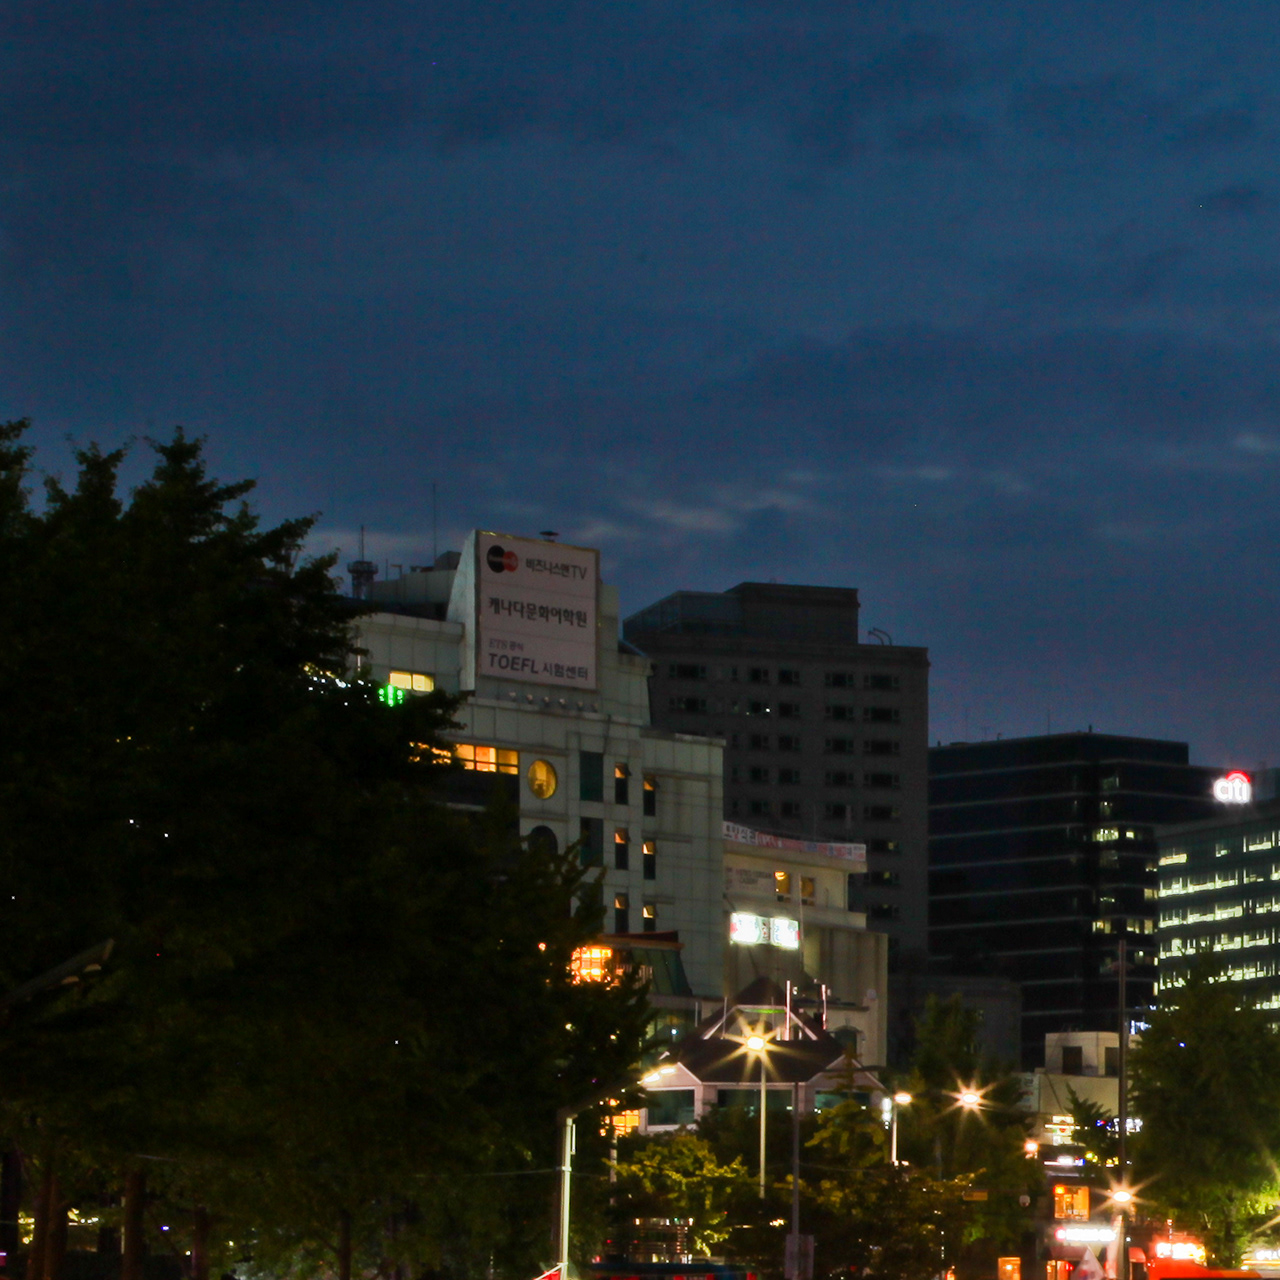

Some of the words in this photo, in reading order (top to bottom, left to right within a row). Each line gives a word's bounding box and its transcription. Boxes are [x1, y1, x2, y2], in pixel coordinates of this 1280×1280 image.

[525, 558, 587, 580] 비즈니스맨TV
[489, 597, 587, 628] 캐나다문화어학원
[488, 653, 539, 674] TOEFL
[542, 663, 588, 681] 시험센터
[1213, 771, 1252, 803] citi
